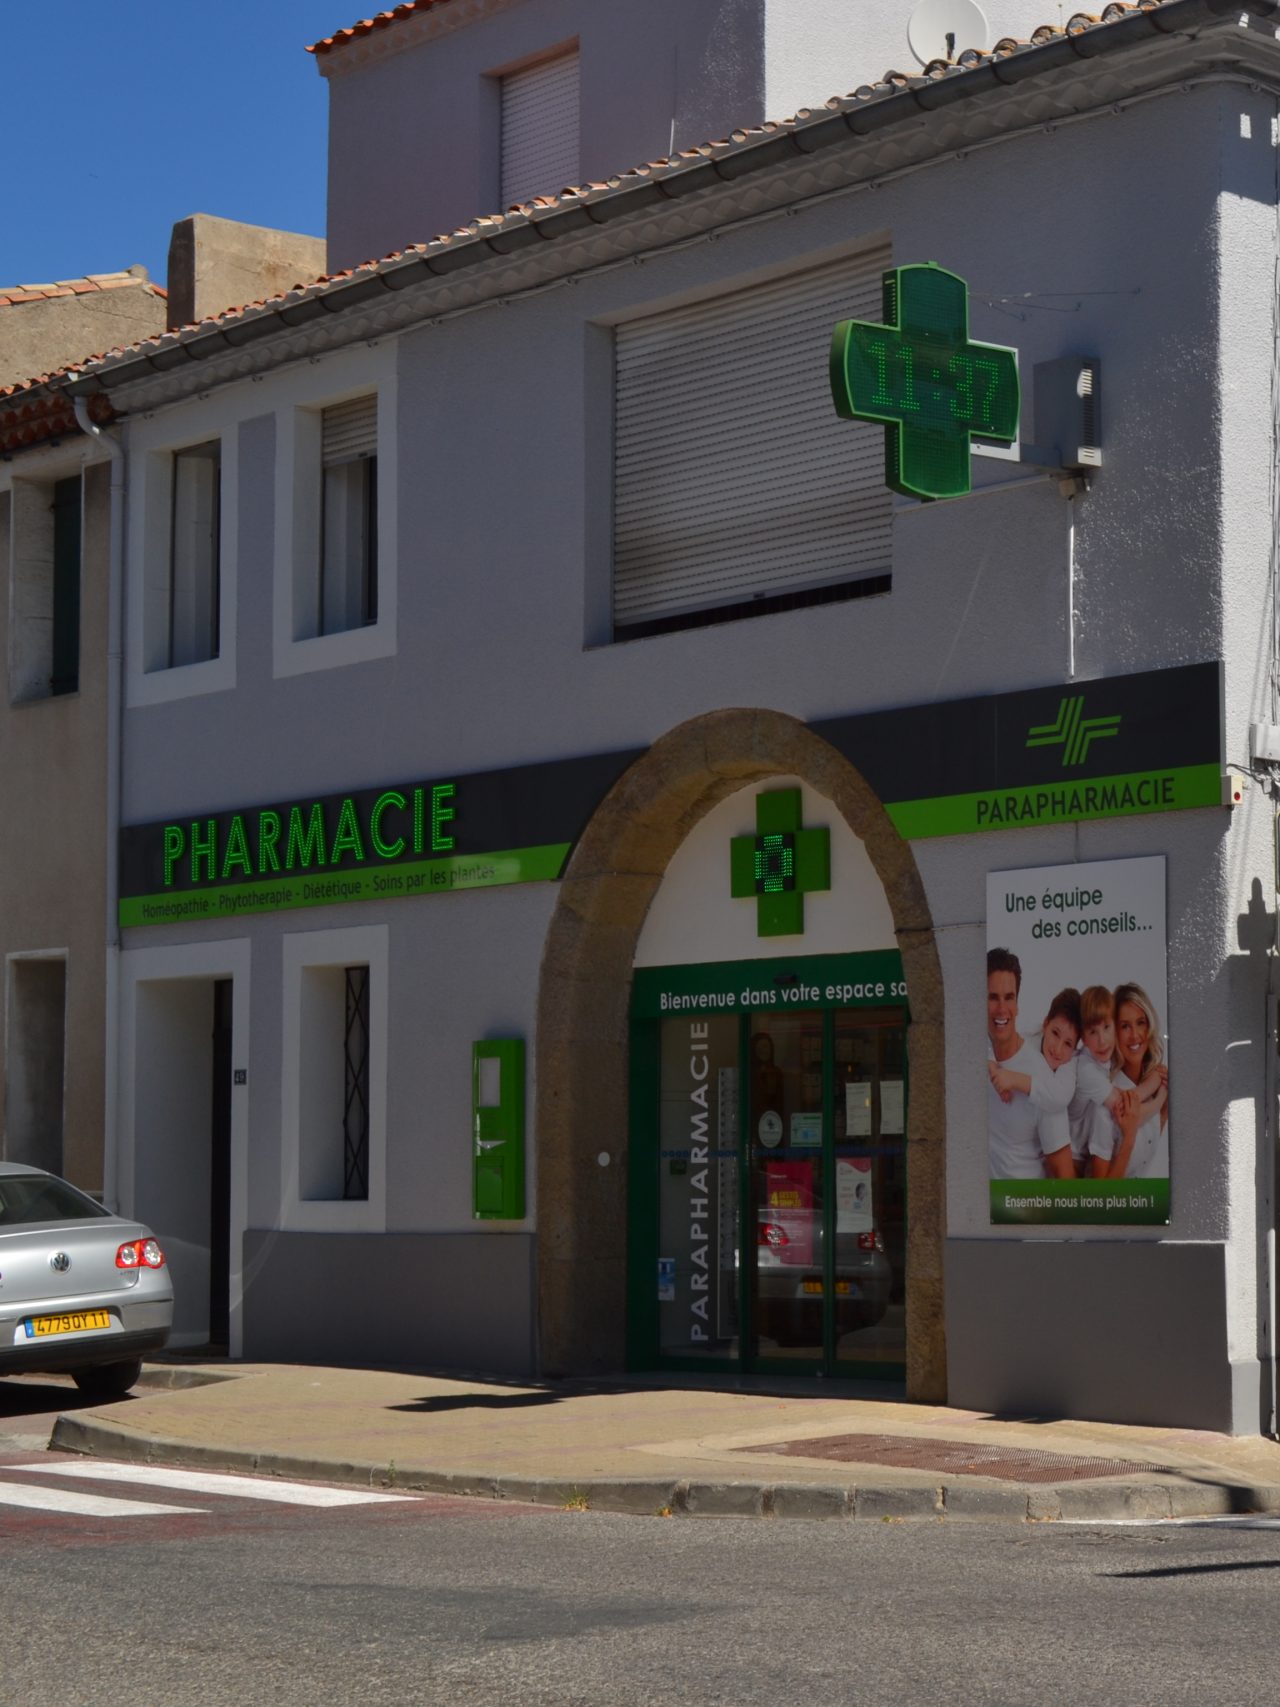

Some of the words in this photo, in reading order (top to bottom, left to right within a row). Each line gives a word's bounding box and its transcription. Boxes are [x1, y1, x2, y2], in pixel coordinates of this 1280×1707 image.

[867, 341, 1000, 422] 11:37
[976, 776, 1176, 825] PARAPHARMACIE
[163, 783, 456, 886] PHARMACIE
[372, 874, 403, 892] Soins
[406, 874, 426, 892] par
[430, 868, 447, 885] les
[1005, 892, 1037, 913] Une
[1041, 886, 1103, 913] équipe
[1031, 918, 1062, 939] des
[659, 991, 736, 1011] Bienvenue
[740, 986, 777, 1006] dans
[781, 983, 820, 1003] votre
[825, 981, 885, 1004] espace
[689, 1021, 710, 1342] PARAPHARMACIE
[1004, 1195, 1052, 1209] Ensemble
[1054, 1197, 1078, 1208] nous
[1080, 1195, 1104, 1208] irons
[1106, 1195, 1127, 1210] plus
[1129, 1195, 1148, 1208] loin
